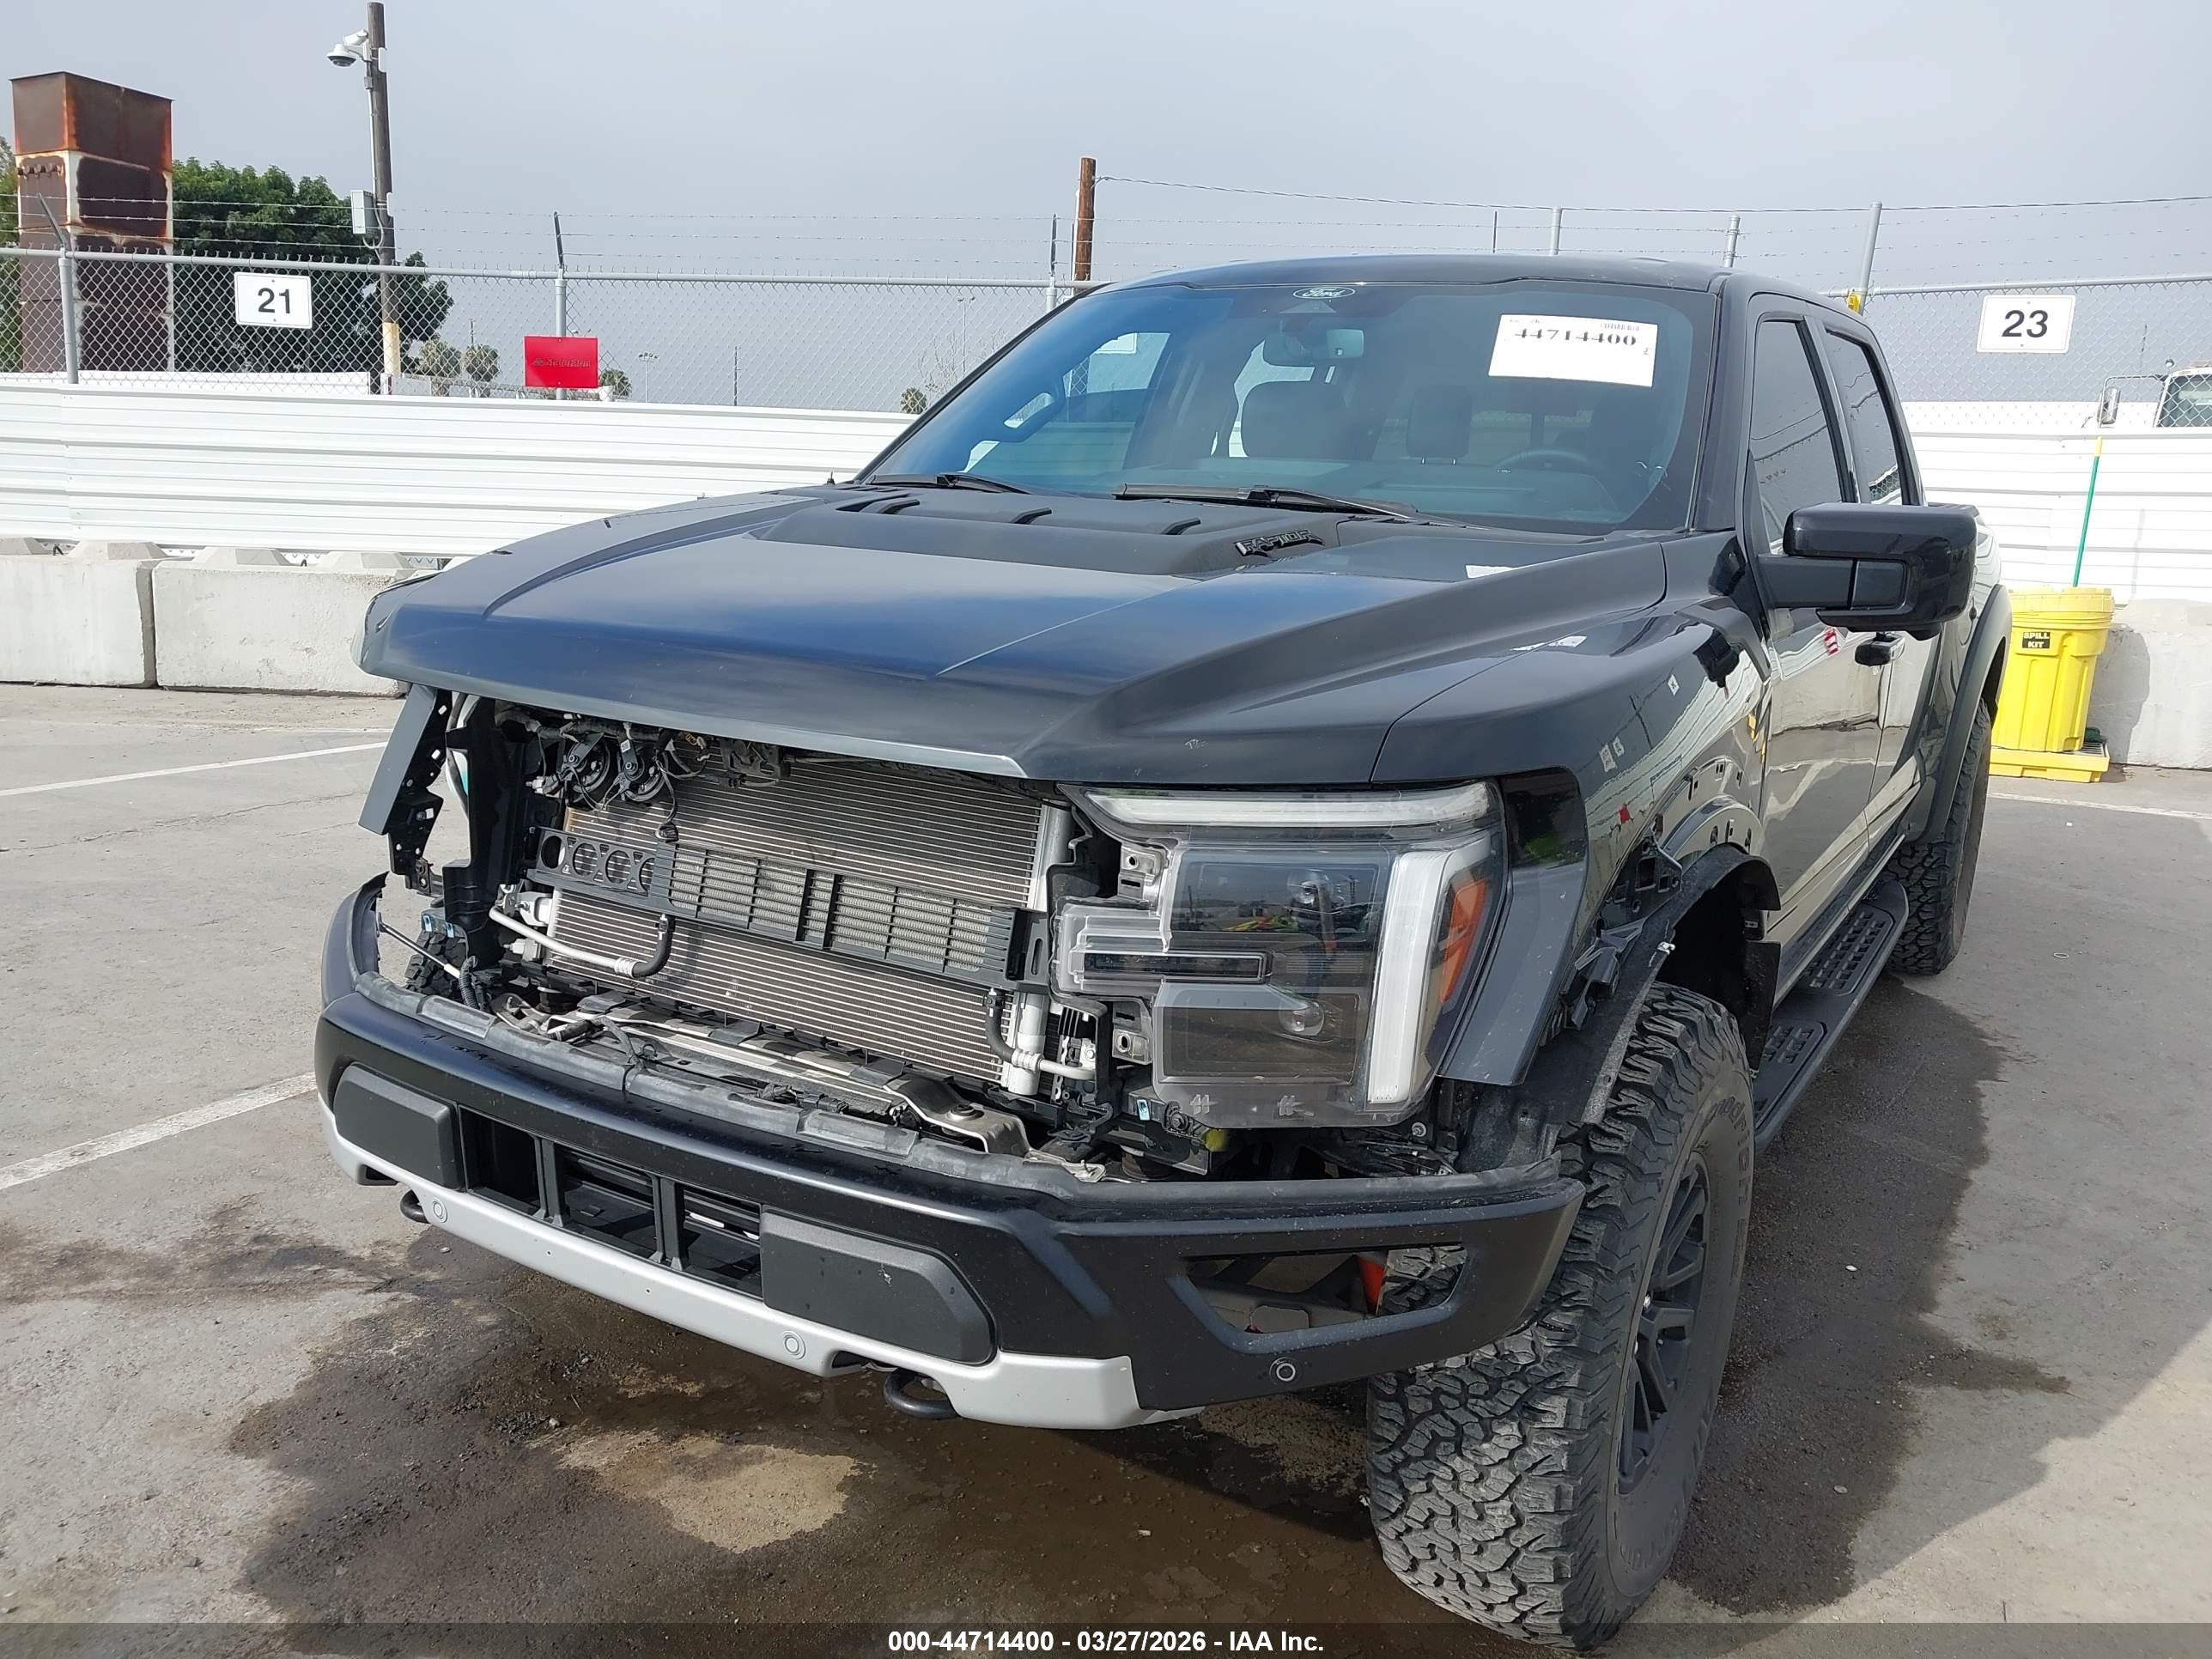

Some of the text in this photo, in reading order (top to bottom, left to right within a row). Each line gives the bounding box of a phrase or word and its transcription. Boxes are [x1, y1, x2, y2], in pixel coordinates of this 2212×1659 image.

[257, 287, 291, 315] 21
[1297, 287, 1350, 298] Ford
[2001, 309, 2049, 338] 23
[1515, 328, 1637, 345] 44714400
[1234, 529, 1325, 557] RAPTOR
[2022, 631, 2050, 640] SPILL
